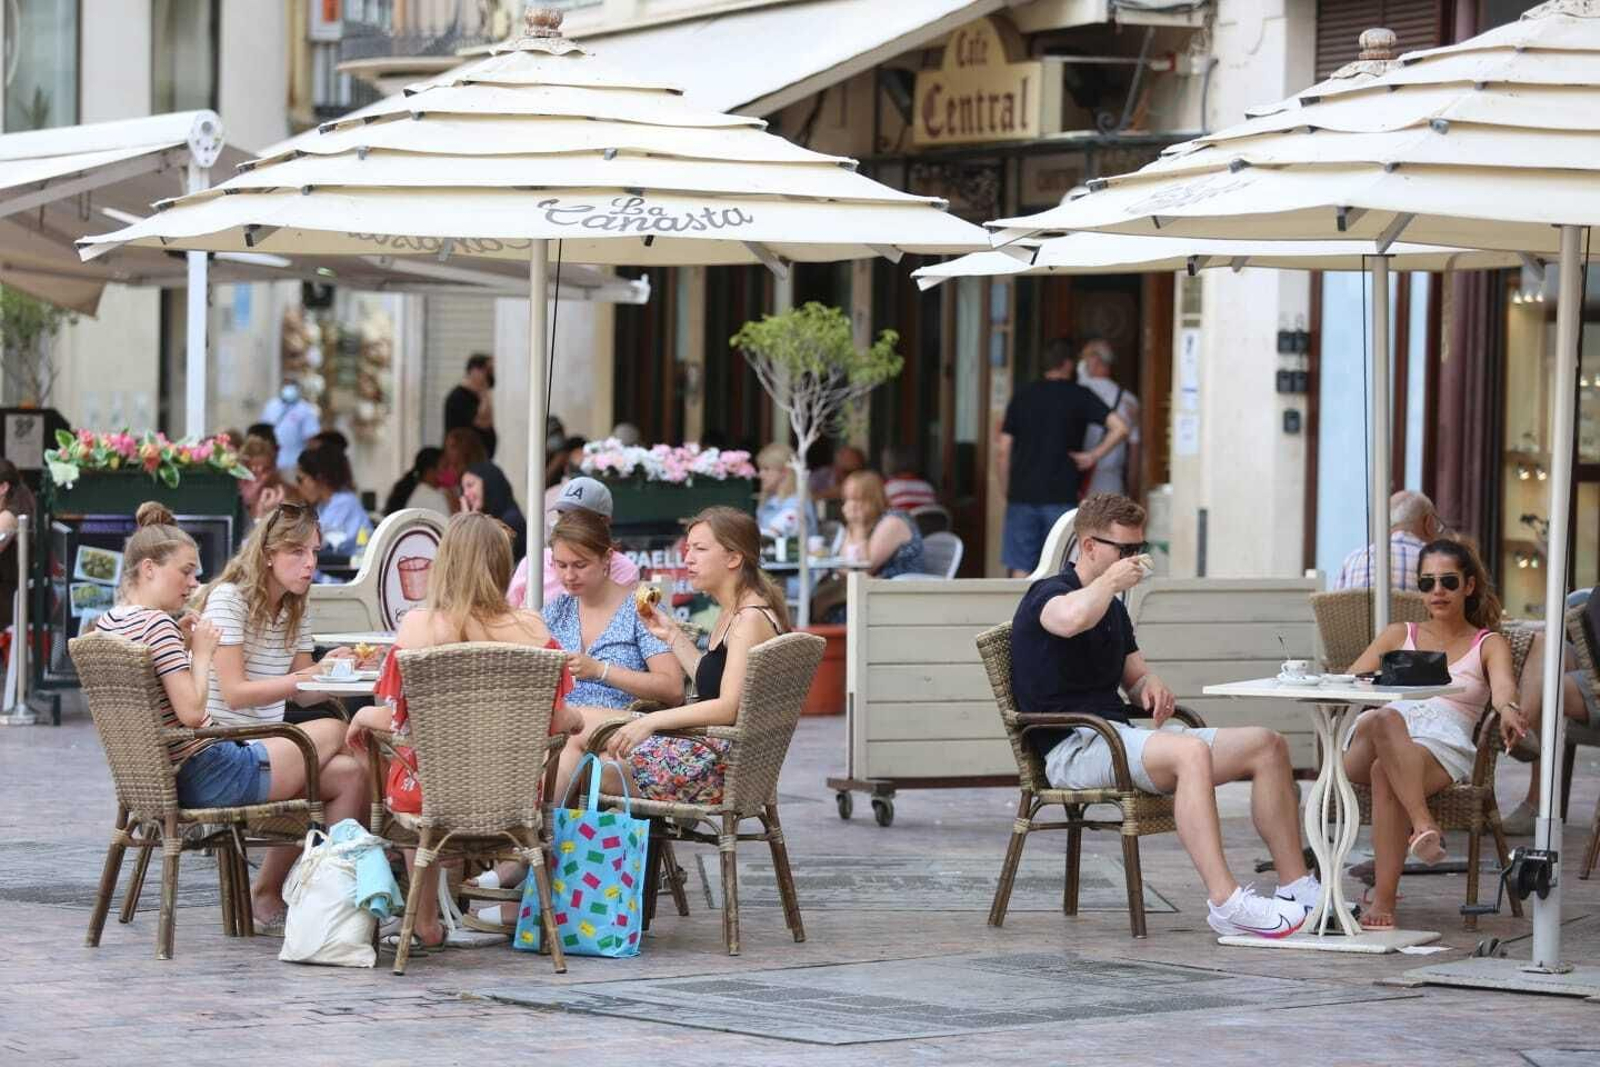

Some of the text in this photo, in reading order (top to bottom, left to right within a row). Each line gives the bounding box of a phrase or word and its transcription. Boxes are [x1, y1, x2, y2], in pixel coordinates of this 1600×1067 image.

[921, 75, 1029, 139] Central
[537, 198, 754, 232] Canasta
[610, 197, 668, 217] La
[564, 484, 583, 500] LA
